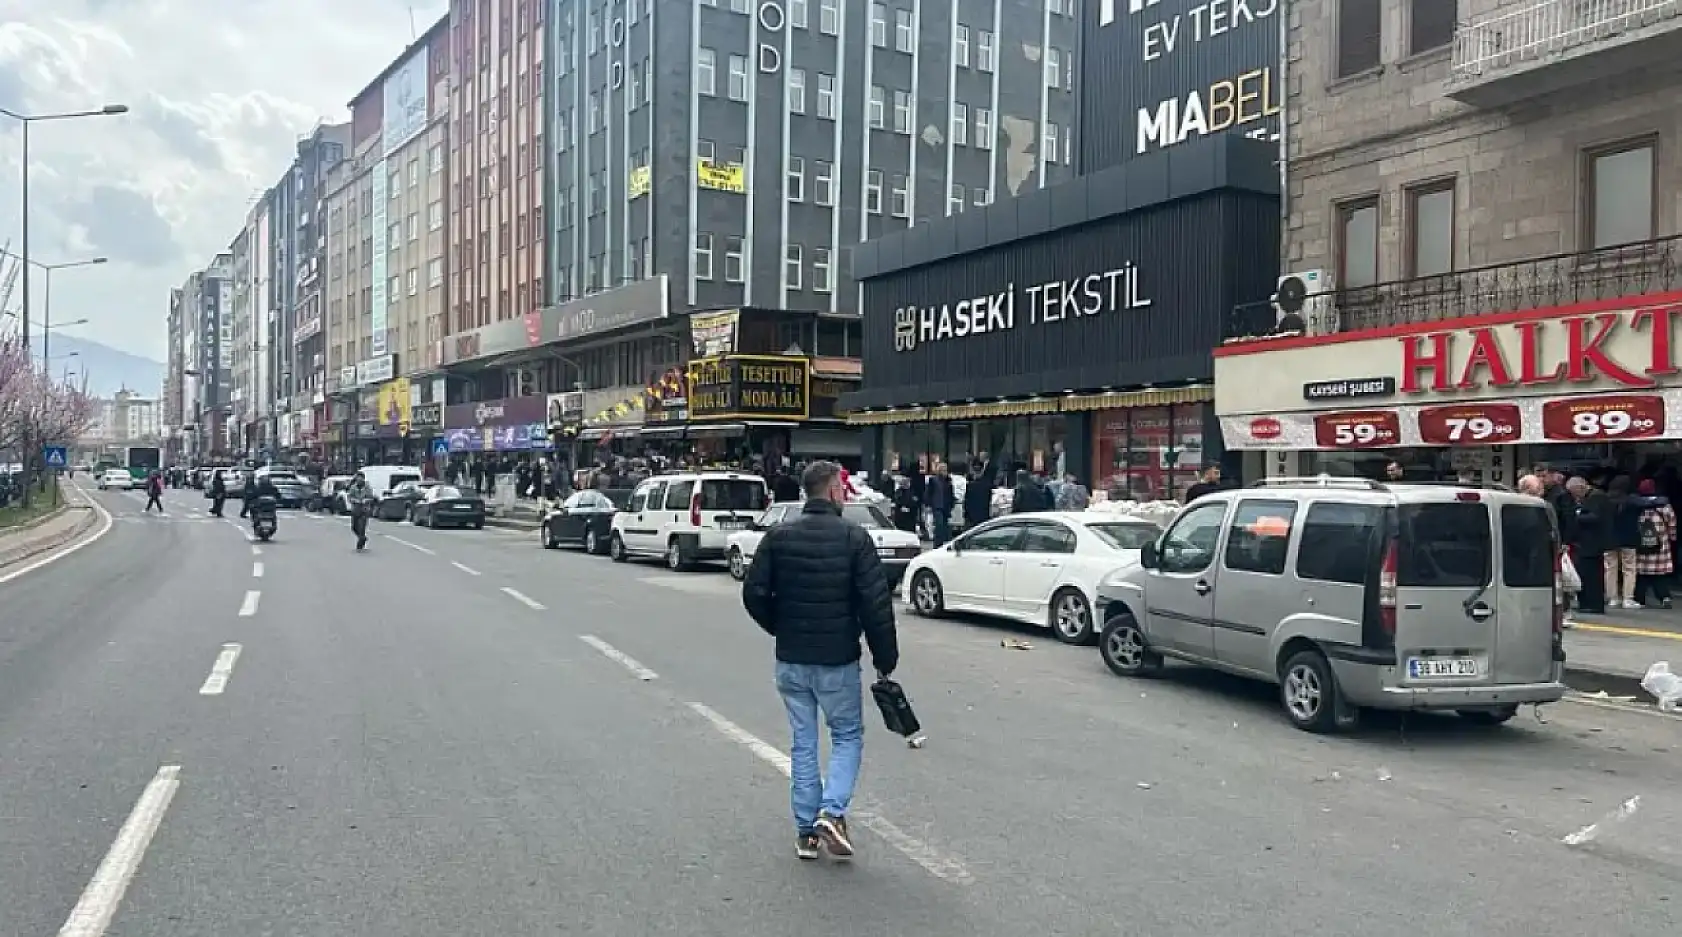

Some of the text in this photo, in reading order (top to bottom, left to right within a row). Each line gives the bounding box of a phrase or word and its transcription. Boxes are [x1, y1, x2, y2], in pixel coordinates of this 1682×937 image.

[1143, 15, 1180, 61] EV
[919, 260, 1152, 342] HASEKİ TEKSTİL
[1335, 424, 1377, 444] 59
[1445, 418, 1494, 440] 79
[1572, 410, 1631, 435] 89
